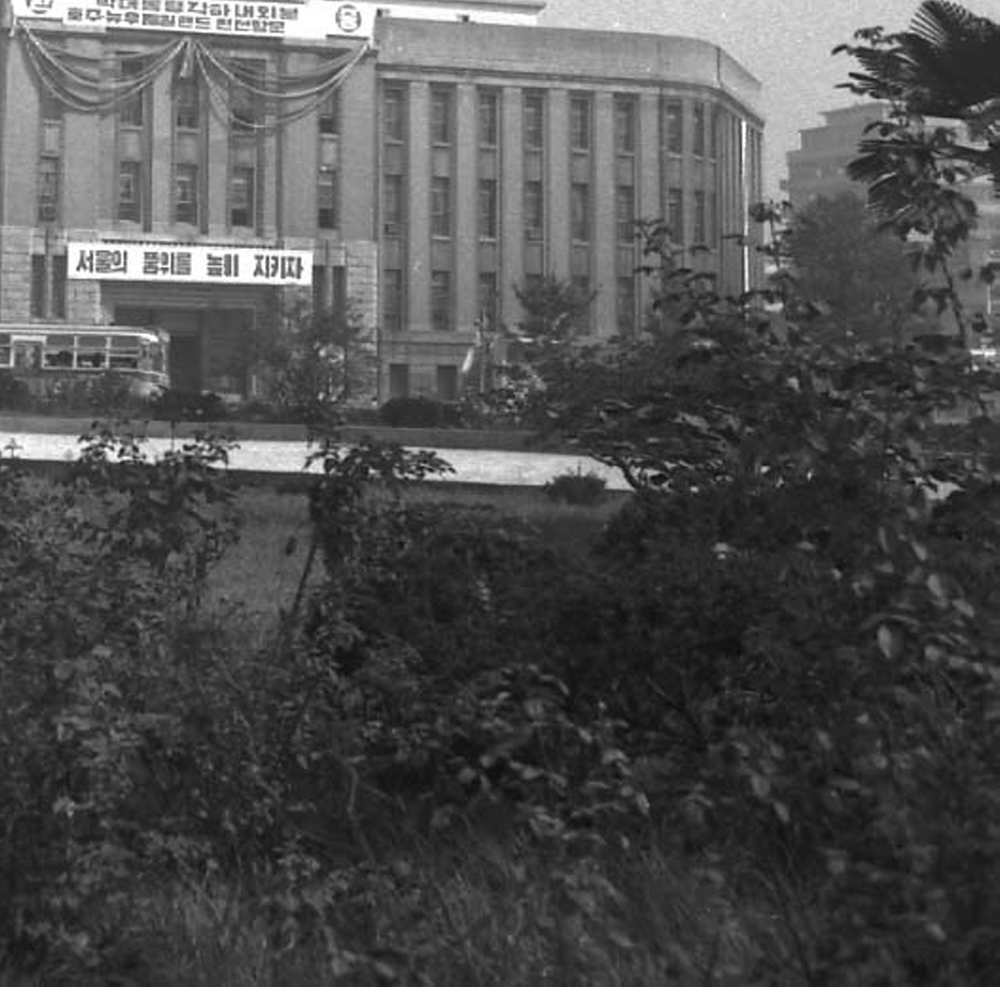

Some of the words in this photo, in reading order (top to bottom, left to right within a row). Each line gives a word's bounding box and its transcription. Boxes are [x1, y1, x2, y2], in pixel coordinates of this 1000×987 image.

[76, 250, 127, 273] 서울의
[143, 252, 191, 275] 품위를
[207, 253, 238, 277] 높이
[253, 254, 304, 279] 지키자
